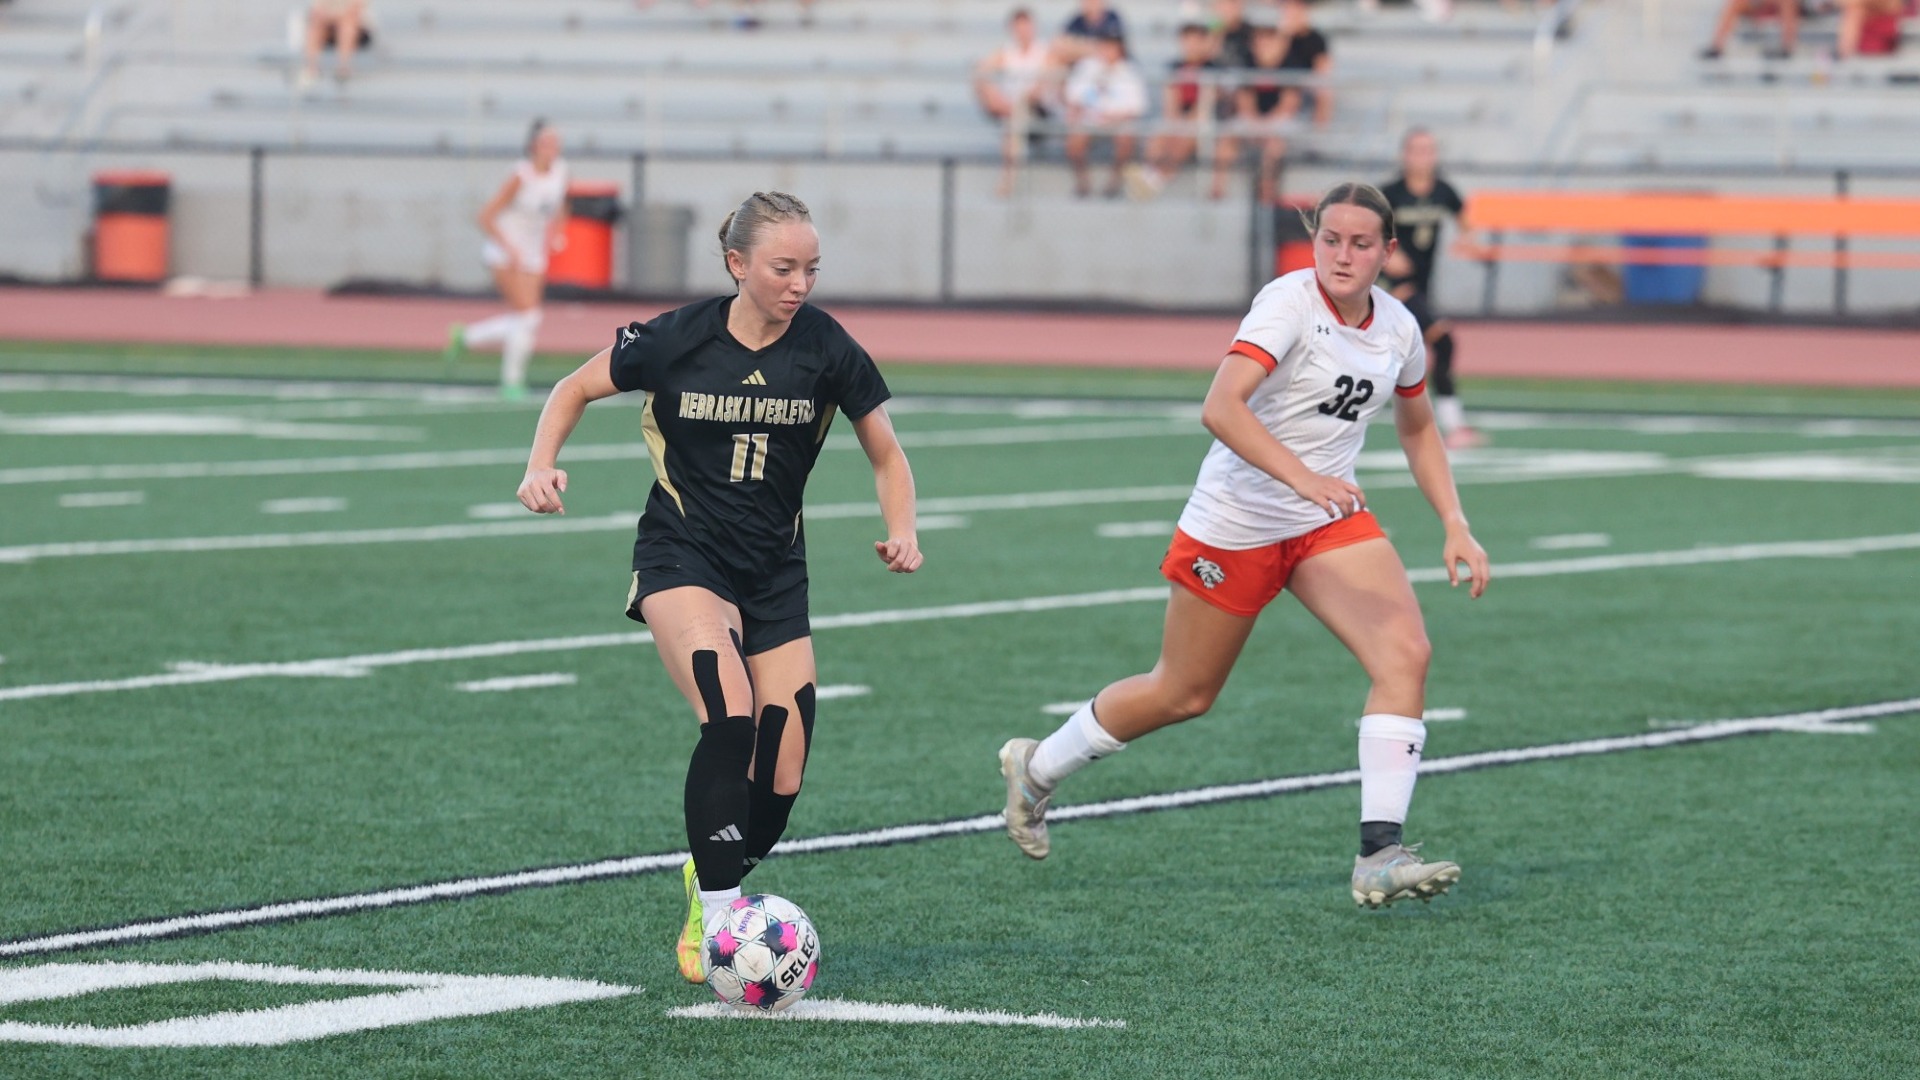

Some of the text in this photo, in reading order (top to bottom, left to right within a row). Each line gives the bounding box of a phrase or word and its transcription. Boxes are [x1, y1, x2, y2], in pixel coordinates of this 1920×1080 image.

[678, 391, 752, 423] NEBRASKA
[1318, 374, 1374, 422] 32
[729, 433, 770, 483] 11
[780, 925, 817, 988] SELECT
